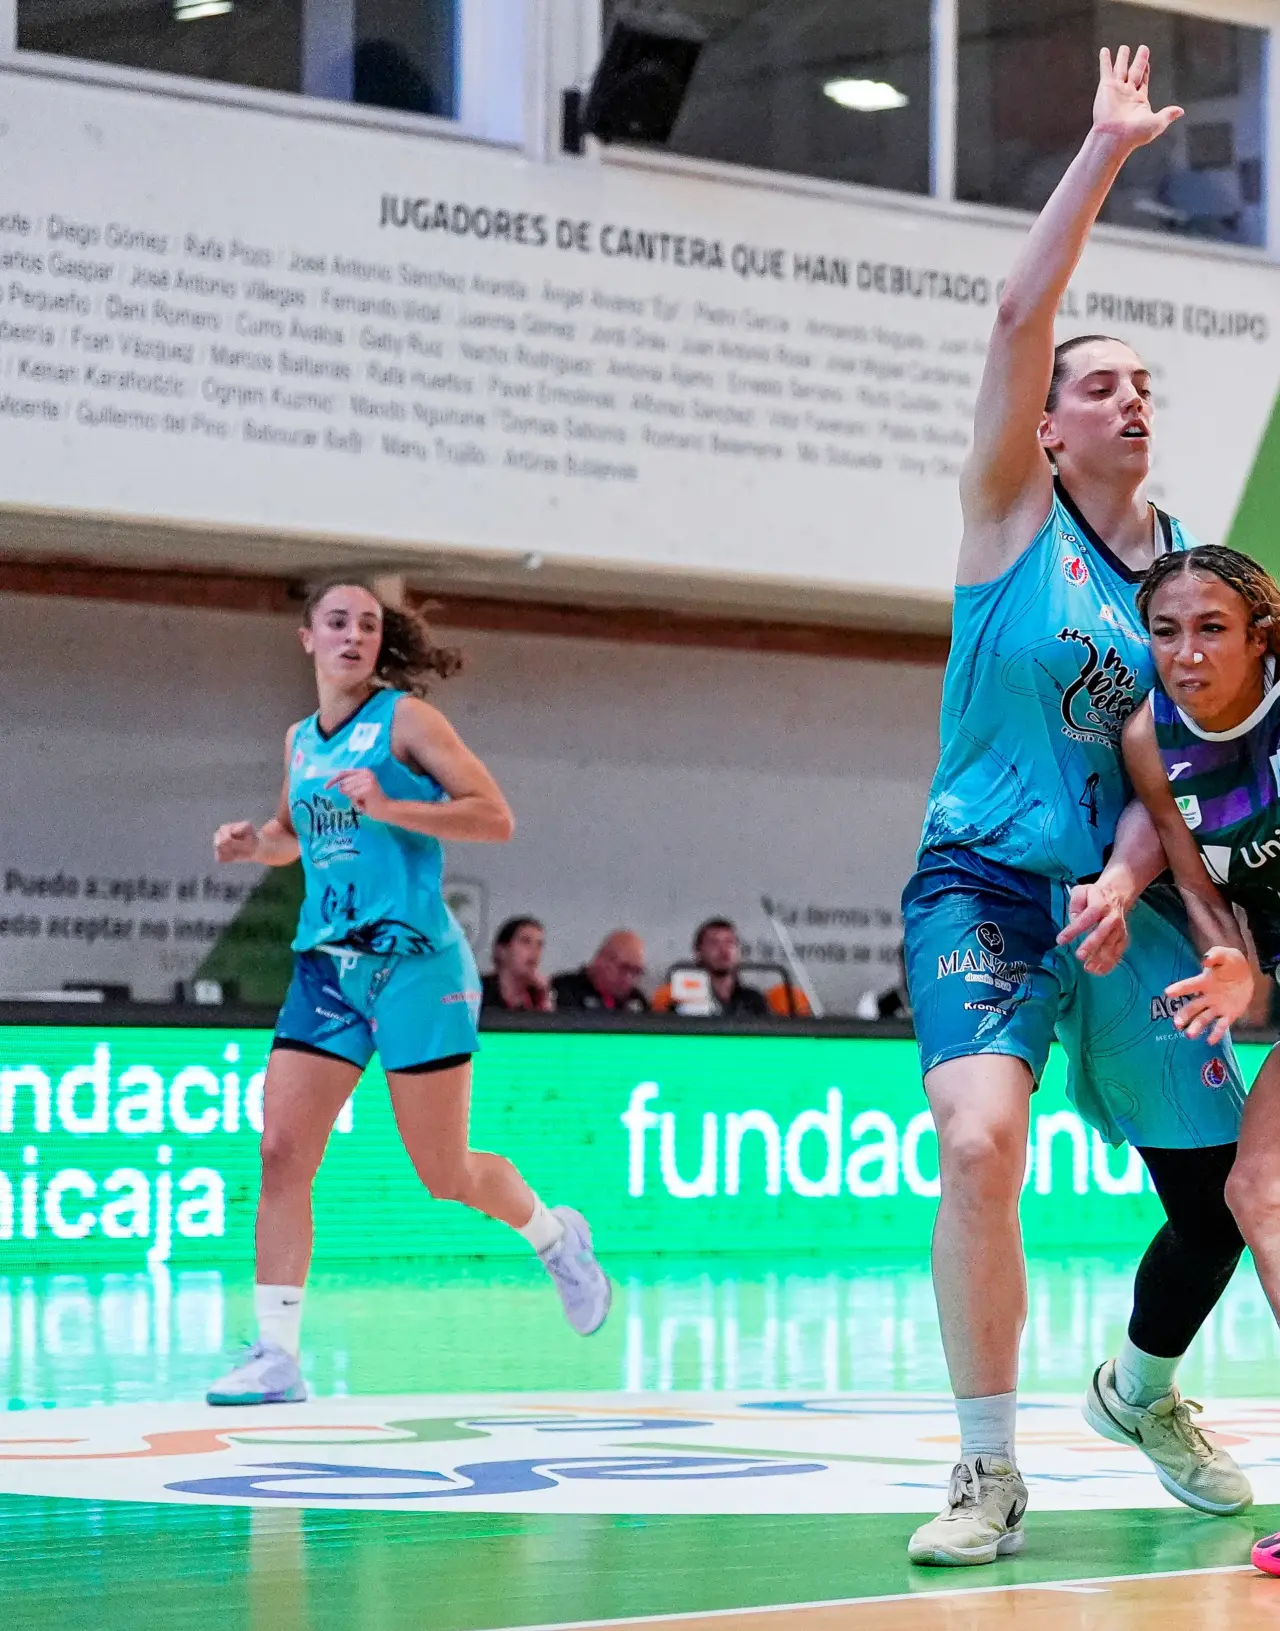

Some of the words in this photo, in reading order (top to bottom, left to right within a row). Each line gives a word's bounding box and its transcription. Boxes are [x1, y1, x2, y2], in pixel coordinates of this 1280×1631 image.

[379, 192, 549, 248] JUGADORES
[555, 216, 591, 254] DE
[599, 222, 724, 271] CANTERA
[731, 241, 784, 282] QUE
[793, 249, 848, 288] HAN
[857, 258, 988, 306] DEBUTADO
[1086, 292, 1175, 331] PRIMER
[1183, 304, 1270, 343] EQUIPO
[5, 868, 80, 898] Puedo
